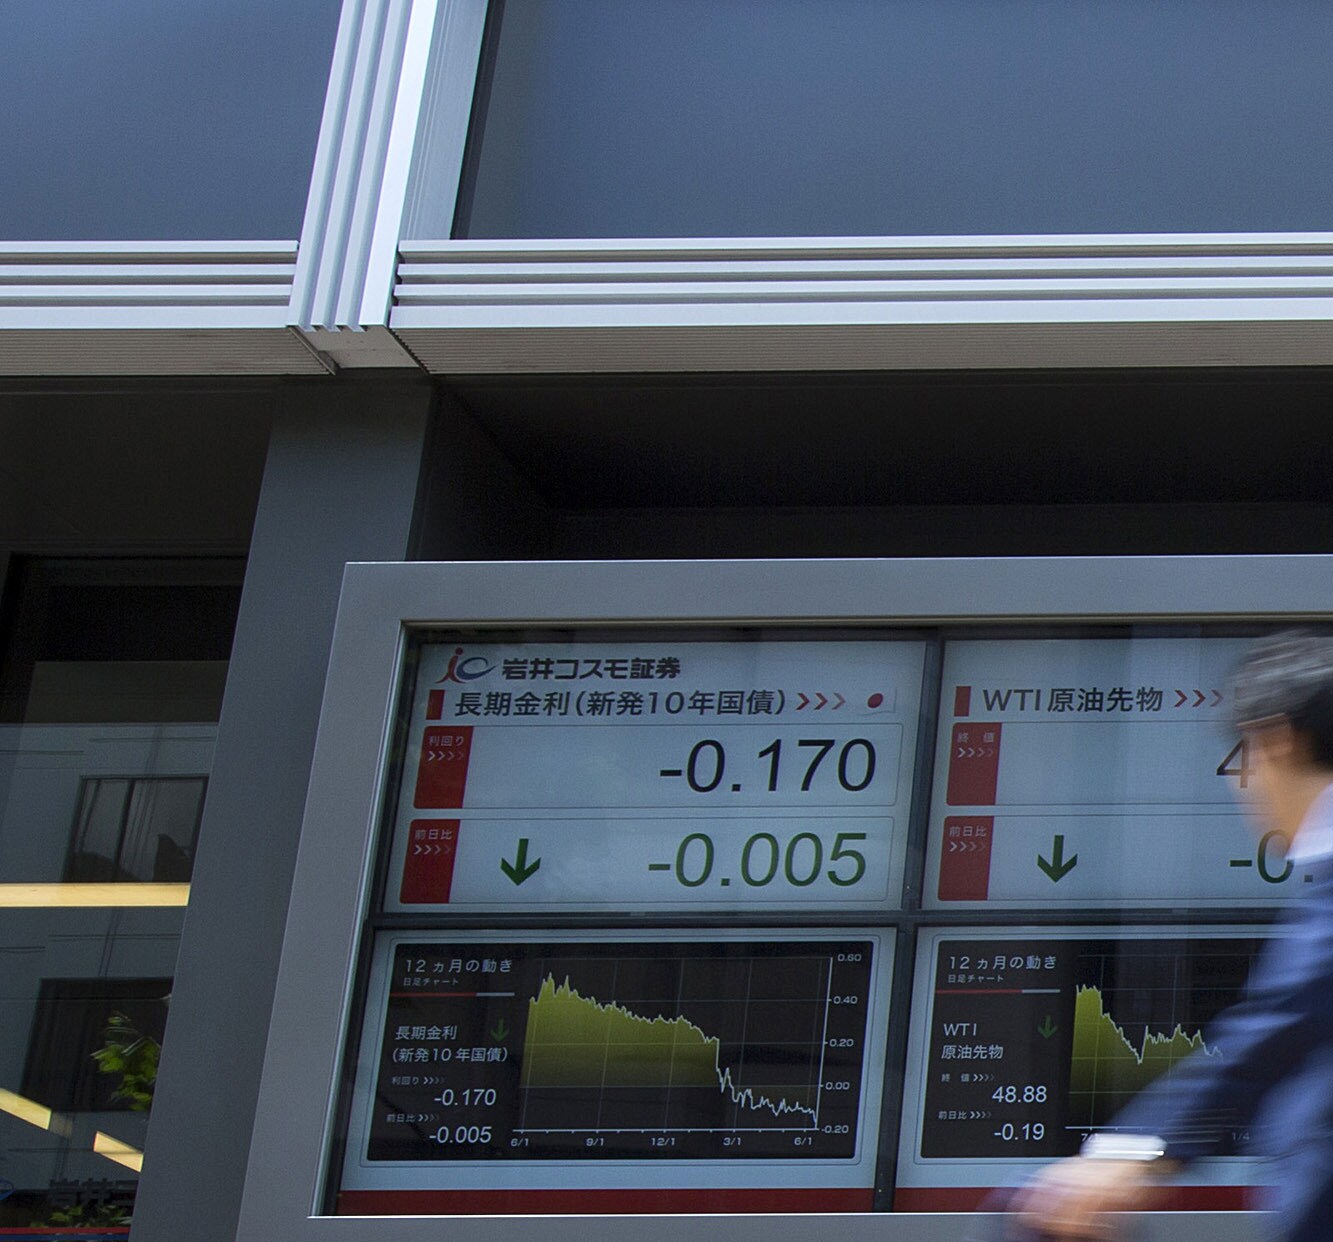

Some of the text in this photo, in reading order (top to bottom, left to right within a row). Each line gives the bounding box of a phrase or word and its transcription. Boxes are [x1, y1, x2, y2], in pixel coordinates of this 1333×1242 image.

[502, 657, 681, 680] 岩井コスモ証券
[428, 734, 465, 747] 利回り
[659, 738, 877, 793] -0.170
[414, 828, 453, 840] 前日比
[949, 825, 988, 837] 前日比
[648, 832, 868, 887] -0.005
[837, 953, 862, 962] 0.60
[403, 977, 459, 986] 日足チャート
[948, 974, 1004, 984] 日足チャート
[833, 995, 858, 1005] 0.40
[395, 1025, 458, 1041] 長期金利
[943, 1023, 978, 1036] WTI
[829, 1038, 854, 1048] 0.20
[941, 1044, 1004, 1060] 原油先物
[825, 1081, 850, 1091] 0.00
[434, 1088, 497, 1106] -0.170
[992, 1085, 1047, 1103] 48.88
[938, 1110, 968, 1120] 前日比
[429, 1126, 493, 1144] -0.005
[821, 1124, 849, 1135] -0.20
[994, 1123, 1045, 1141] -0.19
[511, 1137, 813, 1147] 6/1 9/1 12/1 3/1 6/1
